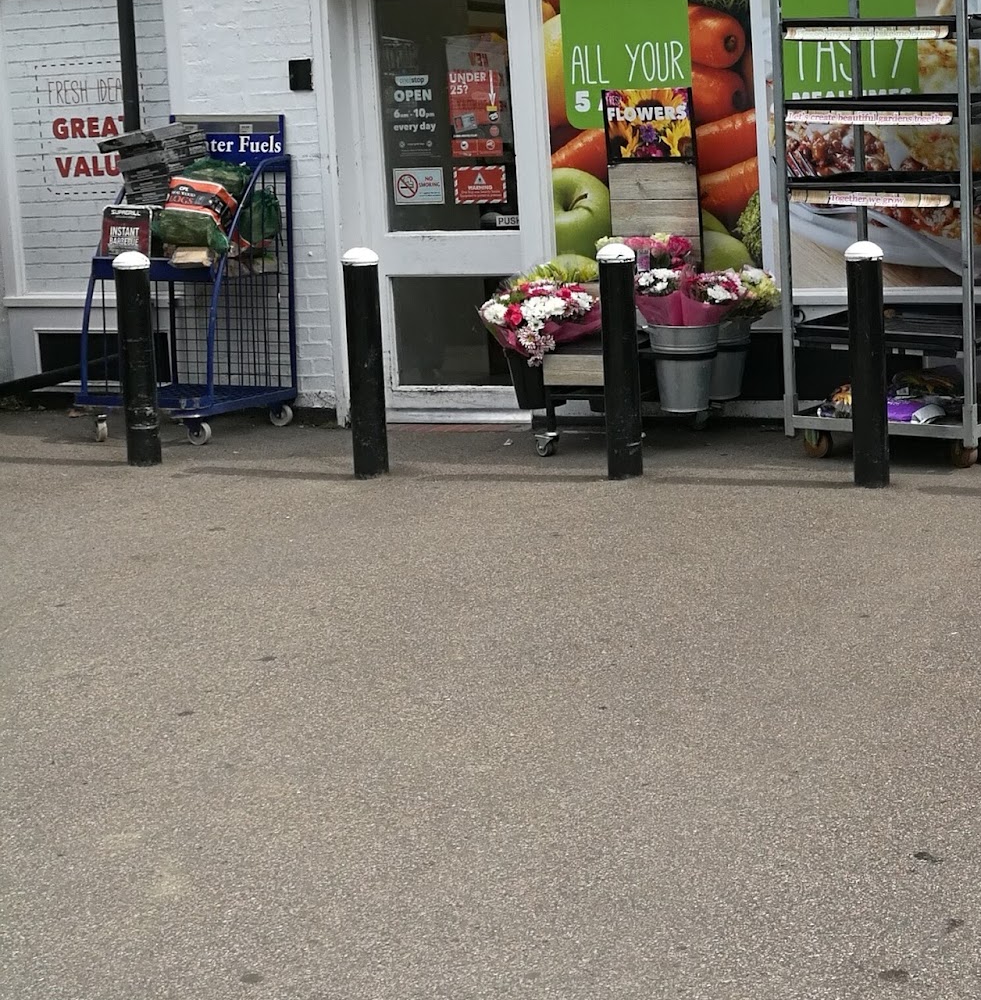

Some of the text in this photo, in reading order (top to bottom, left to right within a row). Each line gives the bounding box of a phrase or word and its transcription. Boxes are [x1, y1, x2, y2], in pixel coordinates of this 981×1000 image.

[571, 40, 684, 85] ALL YOUR
[411, 76, 425, 84] stop
[448, 72, 487, 83] UNDER
[47, 80, 89, 105] FRESH
[393, 89, 433, 102] OPEN
[449, 84, 469, 95] 25?
[574, 90, 591, 113] 5
[606, 104, 688, 122] FLOWERS
[838, 113, 877, 122] beautiful
[878, 114, 913, 123] gardens
[393, 121, 437, 133] every day
[239, 135, 282, 153] Fuels
[55, 154, 122, 178] VALU
[830, 194, 867, 204] Together
[883, 196, 905, 204] grow
[110, 225, 140, 236] INSTANT
